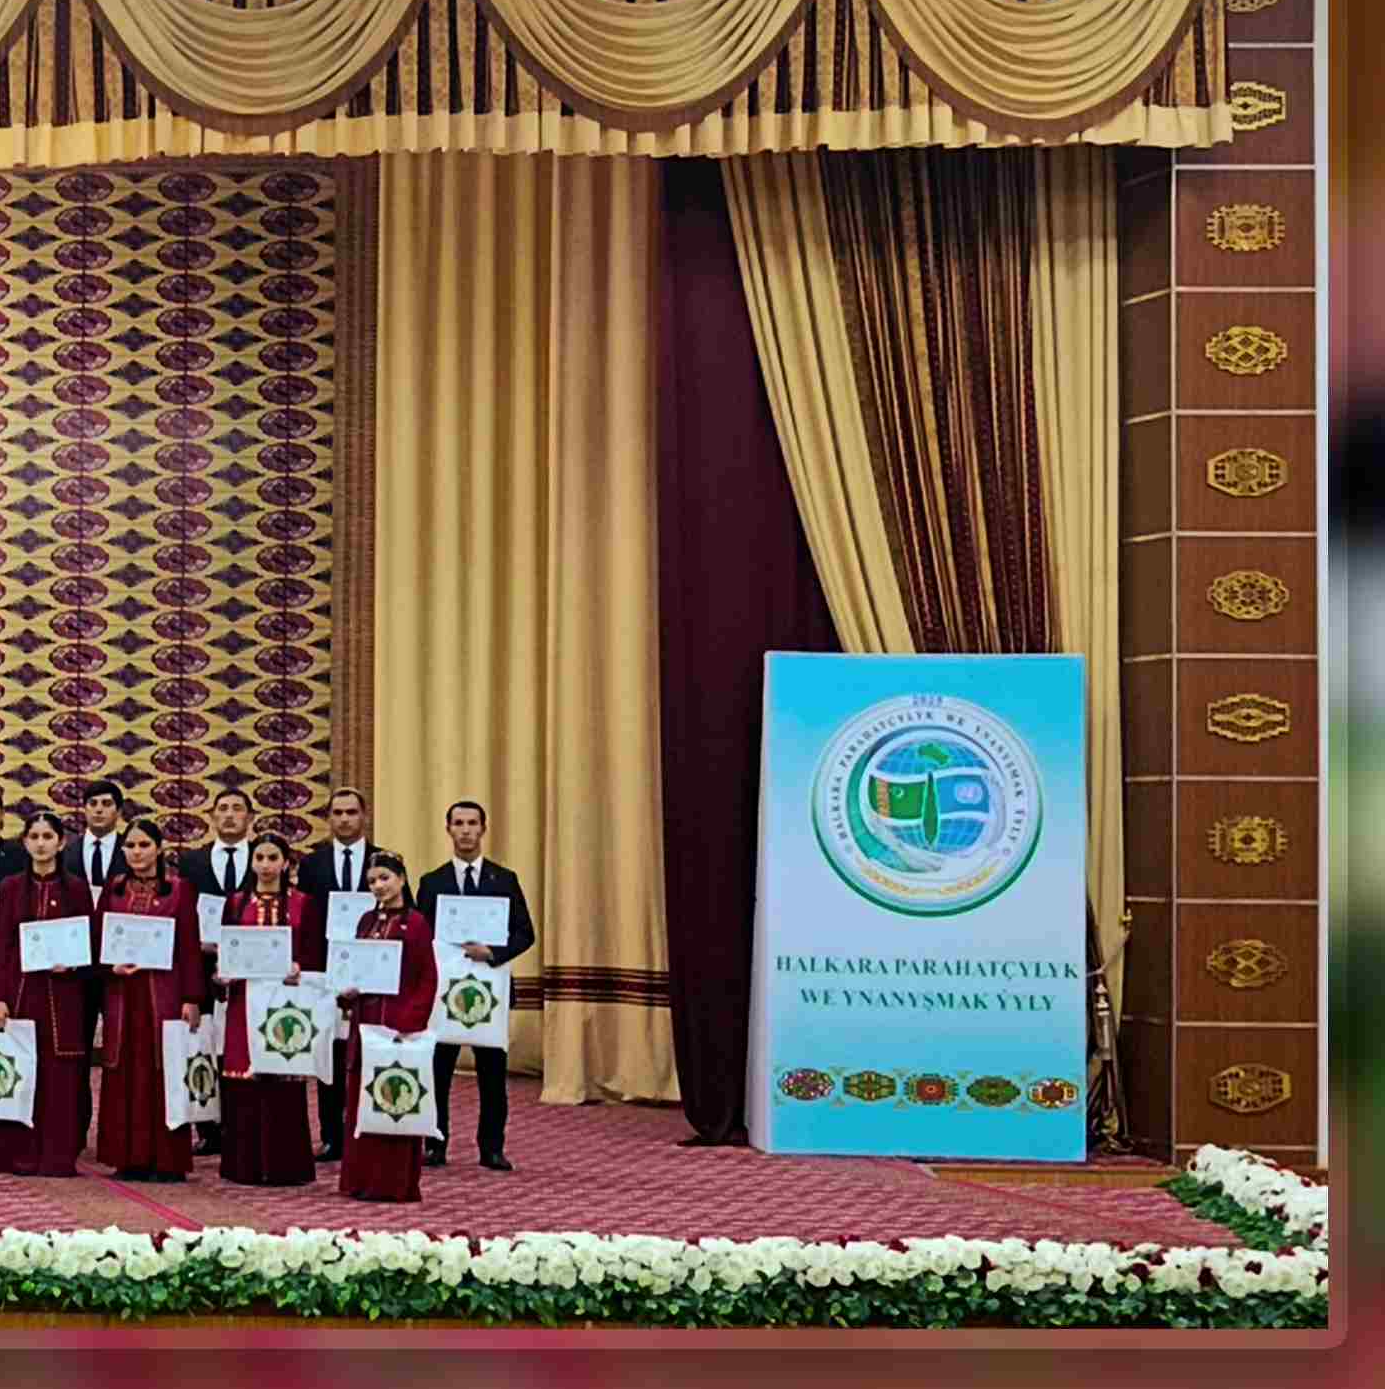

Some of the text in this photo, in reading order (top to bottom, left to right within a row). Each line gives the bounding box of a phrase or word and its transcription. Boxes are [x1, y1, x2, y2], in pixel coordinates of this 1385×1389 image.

[776, 956, 1078, 980] HALKARA PARAHATÇYLYK
[800, 988, 1056, 1011] WE YNANYŞMAK ÝYLY
